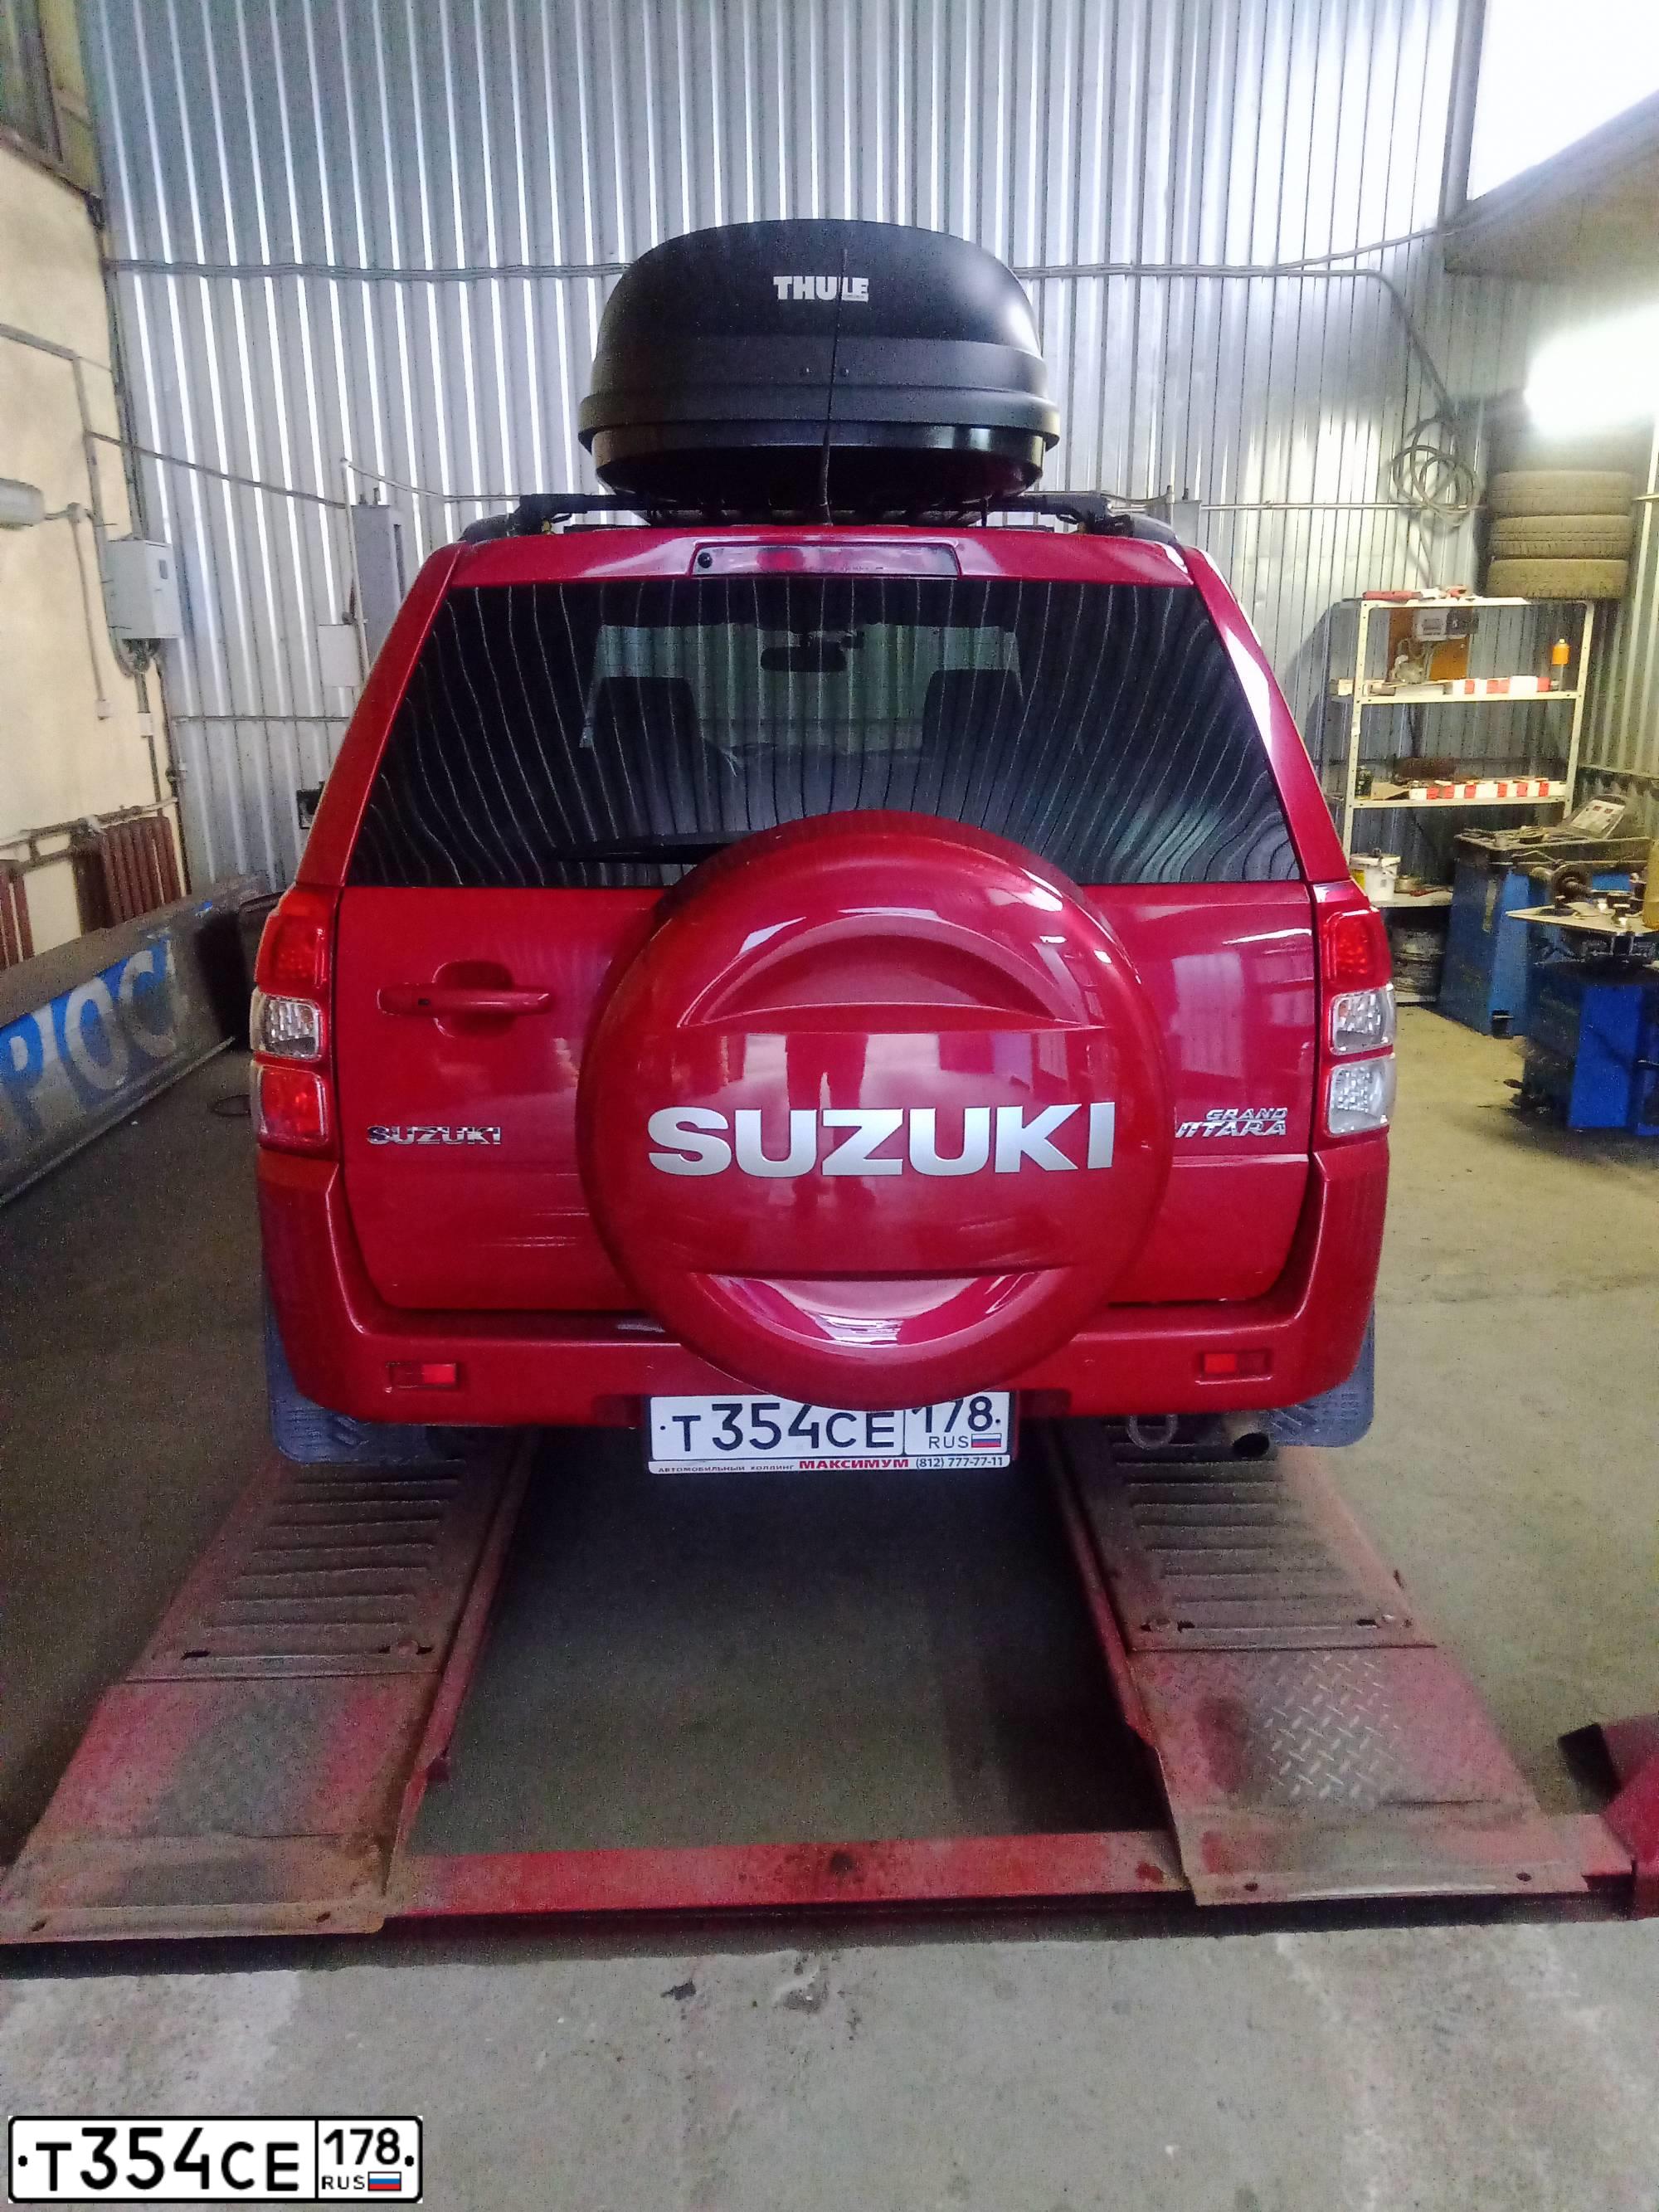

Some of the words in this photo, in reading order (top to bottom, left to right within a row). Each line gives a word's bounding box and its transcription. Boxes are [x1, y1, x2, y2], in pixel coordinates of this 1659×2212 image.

[773, 275, 869, 301] THULE
[1205, 1107, 1287, 1120] GRAND
[367, 1125, 501, 1145] SUZUKI
[648, 1102, 1116, 1177] SUZUKI
[928, 1435, 969, 1449] RUS
[799, 1458, 909, 1469] МАКСИМУМ
[915, 1457, 945, 1469] (812)
[947, 1455, 1004, 1468] 777-77-11
